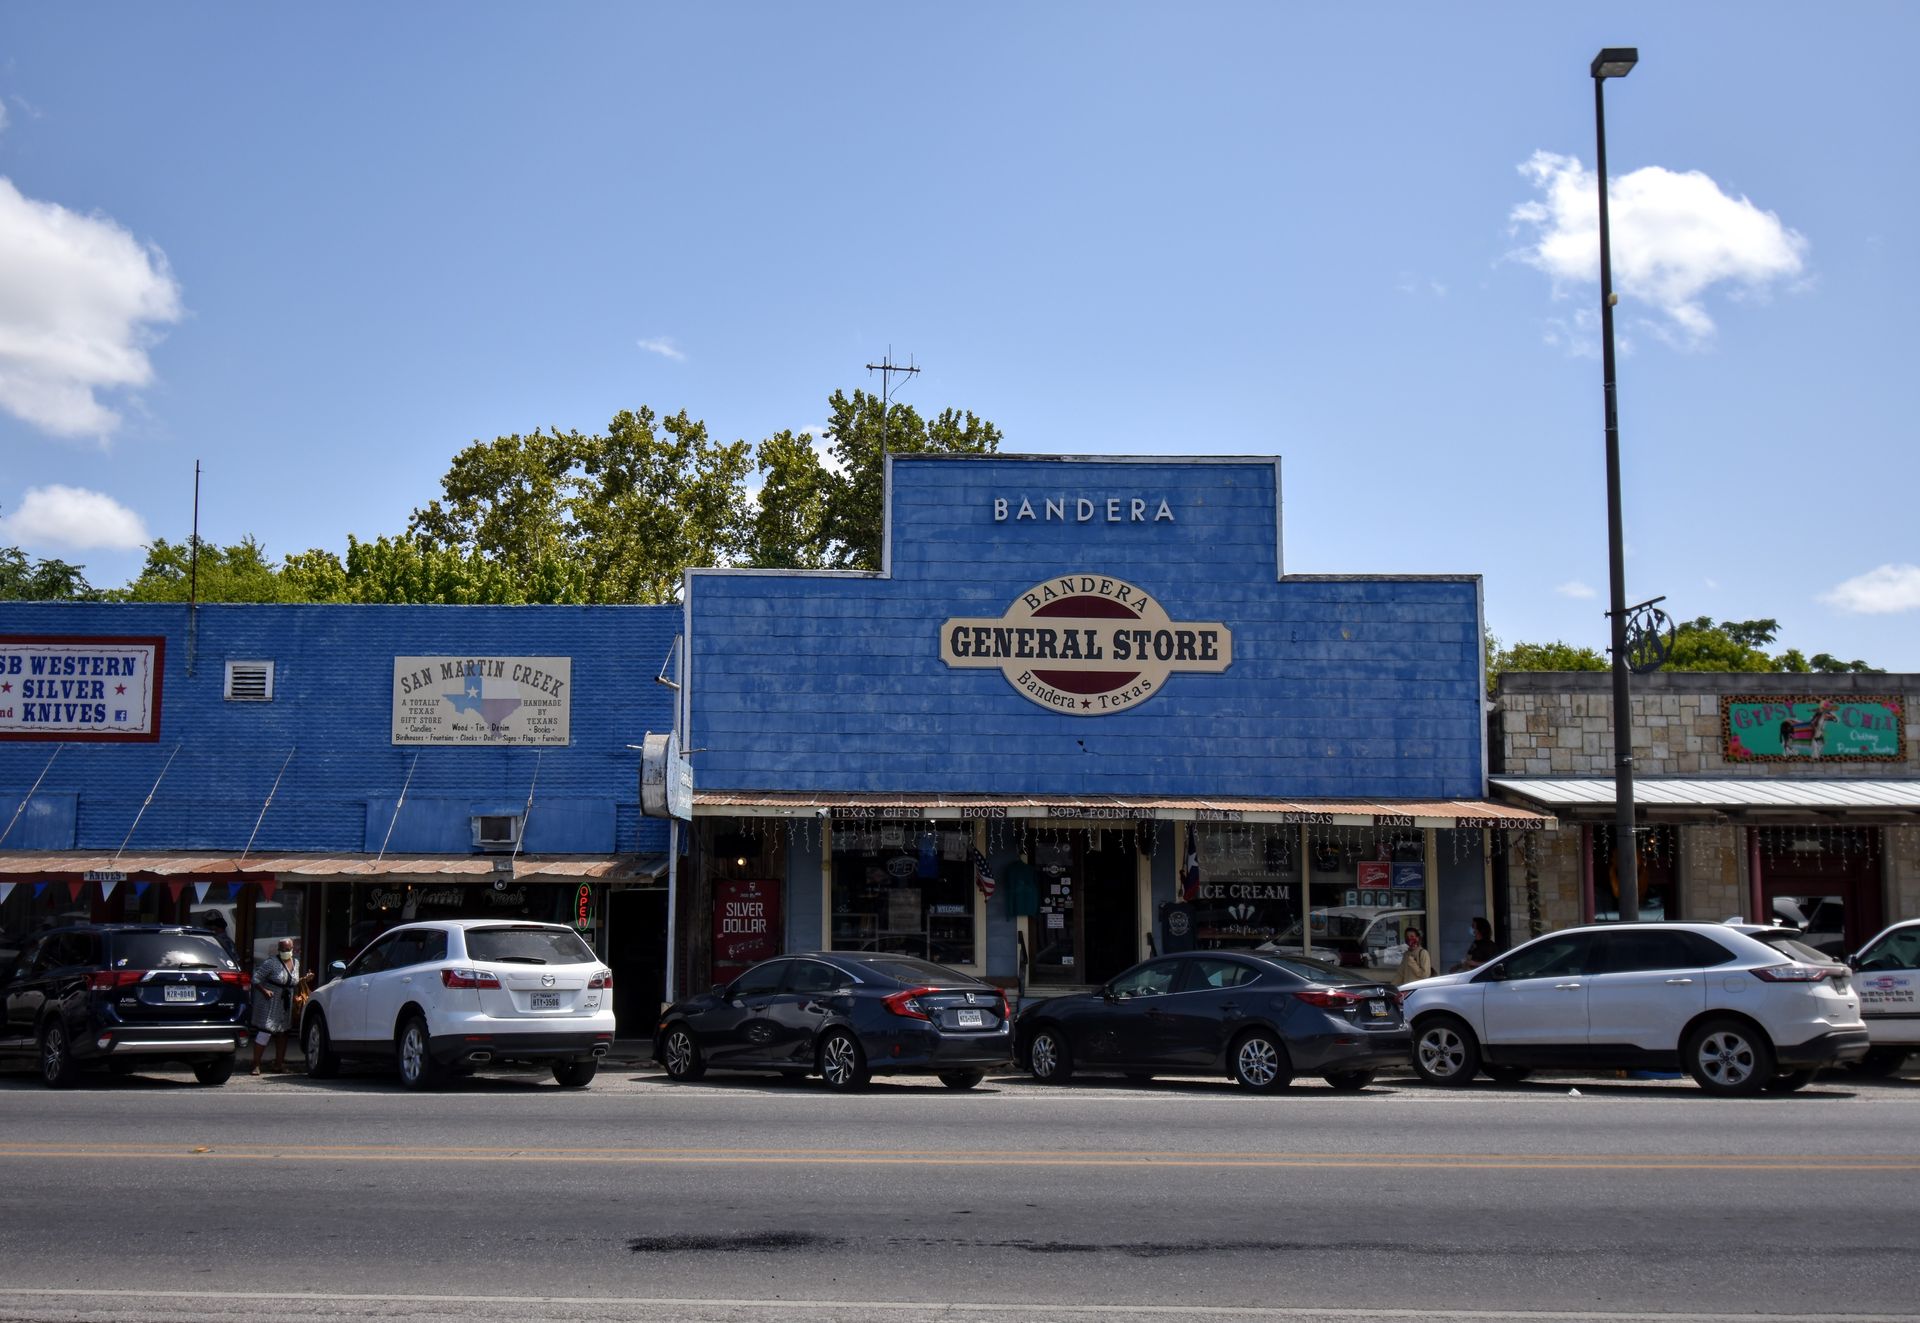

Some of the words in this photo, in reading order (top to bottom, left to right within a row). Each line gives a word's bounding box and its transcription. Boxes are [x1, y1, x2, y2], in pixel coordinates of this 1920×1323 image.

[994, 498, 1175, 521] BANDERA
[1023, 577, 1148, 614] BANDERA
[950, 625, 1103, 660] GENERAL
[1113, 629, 1218, 661] STORE
[31, 656, 136, 676] WESTERN
[401, 667, 433, 694] SAN
[440, 659, 505, 679] MARTIN
[513, 664, 564, 698] CREEK
[22, 679, 105, 699] SILVER
[1017, 671, 1075, 709] Bandera
[1098, 679, 1152, 709] Texas
[410, 699, 440, 707] TOTALLY
[524, 699, 561, 707] HANDMADE
[22, 703, 106, 722] KNIVES
[452, 723, 468, 731] Wood
[475, 723, 485, 731] Tin
[492, 723, 510, 731] Denim
[527, 717, 558, 725] TEXANS
[410, 725, 432, 733] Candles
[533, 725, 550, 733] Books
[460, 734, 477, 742] Clocks
[522, 734, 536, 743] Flags
[834, 807, 876, 818] TEXAS
[883, 808, 920, 818] GIFTS
[963, 807, 1006, 818] BOOTS
[1050, 807, 1083, 818] SODA
[1090, 808, 1155, 819] FOUNTAIN
[1200, 810, 1241, 821] MALTS
[1285, 812, 1334, 824] SALSAS
[1378, 815, 1412, 827] JAMS
[1458, 818, 1484, 828] ART
[1500, 818, 1542, 829] BOOKS
[89, 871, 121, 880] KNIVES
[1200, 885, 1226, 899] ICE
[1230, 884, 1290, 900] CREAM
[578, 885, 588, 927] OPEN
[726, 903, 763, 917] SILVER
[937, 905, 965, 913] WELCOME
[723, 919, 767, 933] DOLLAR
